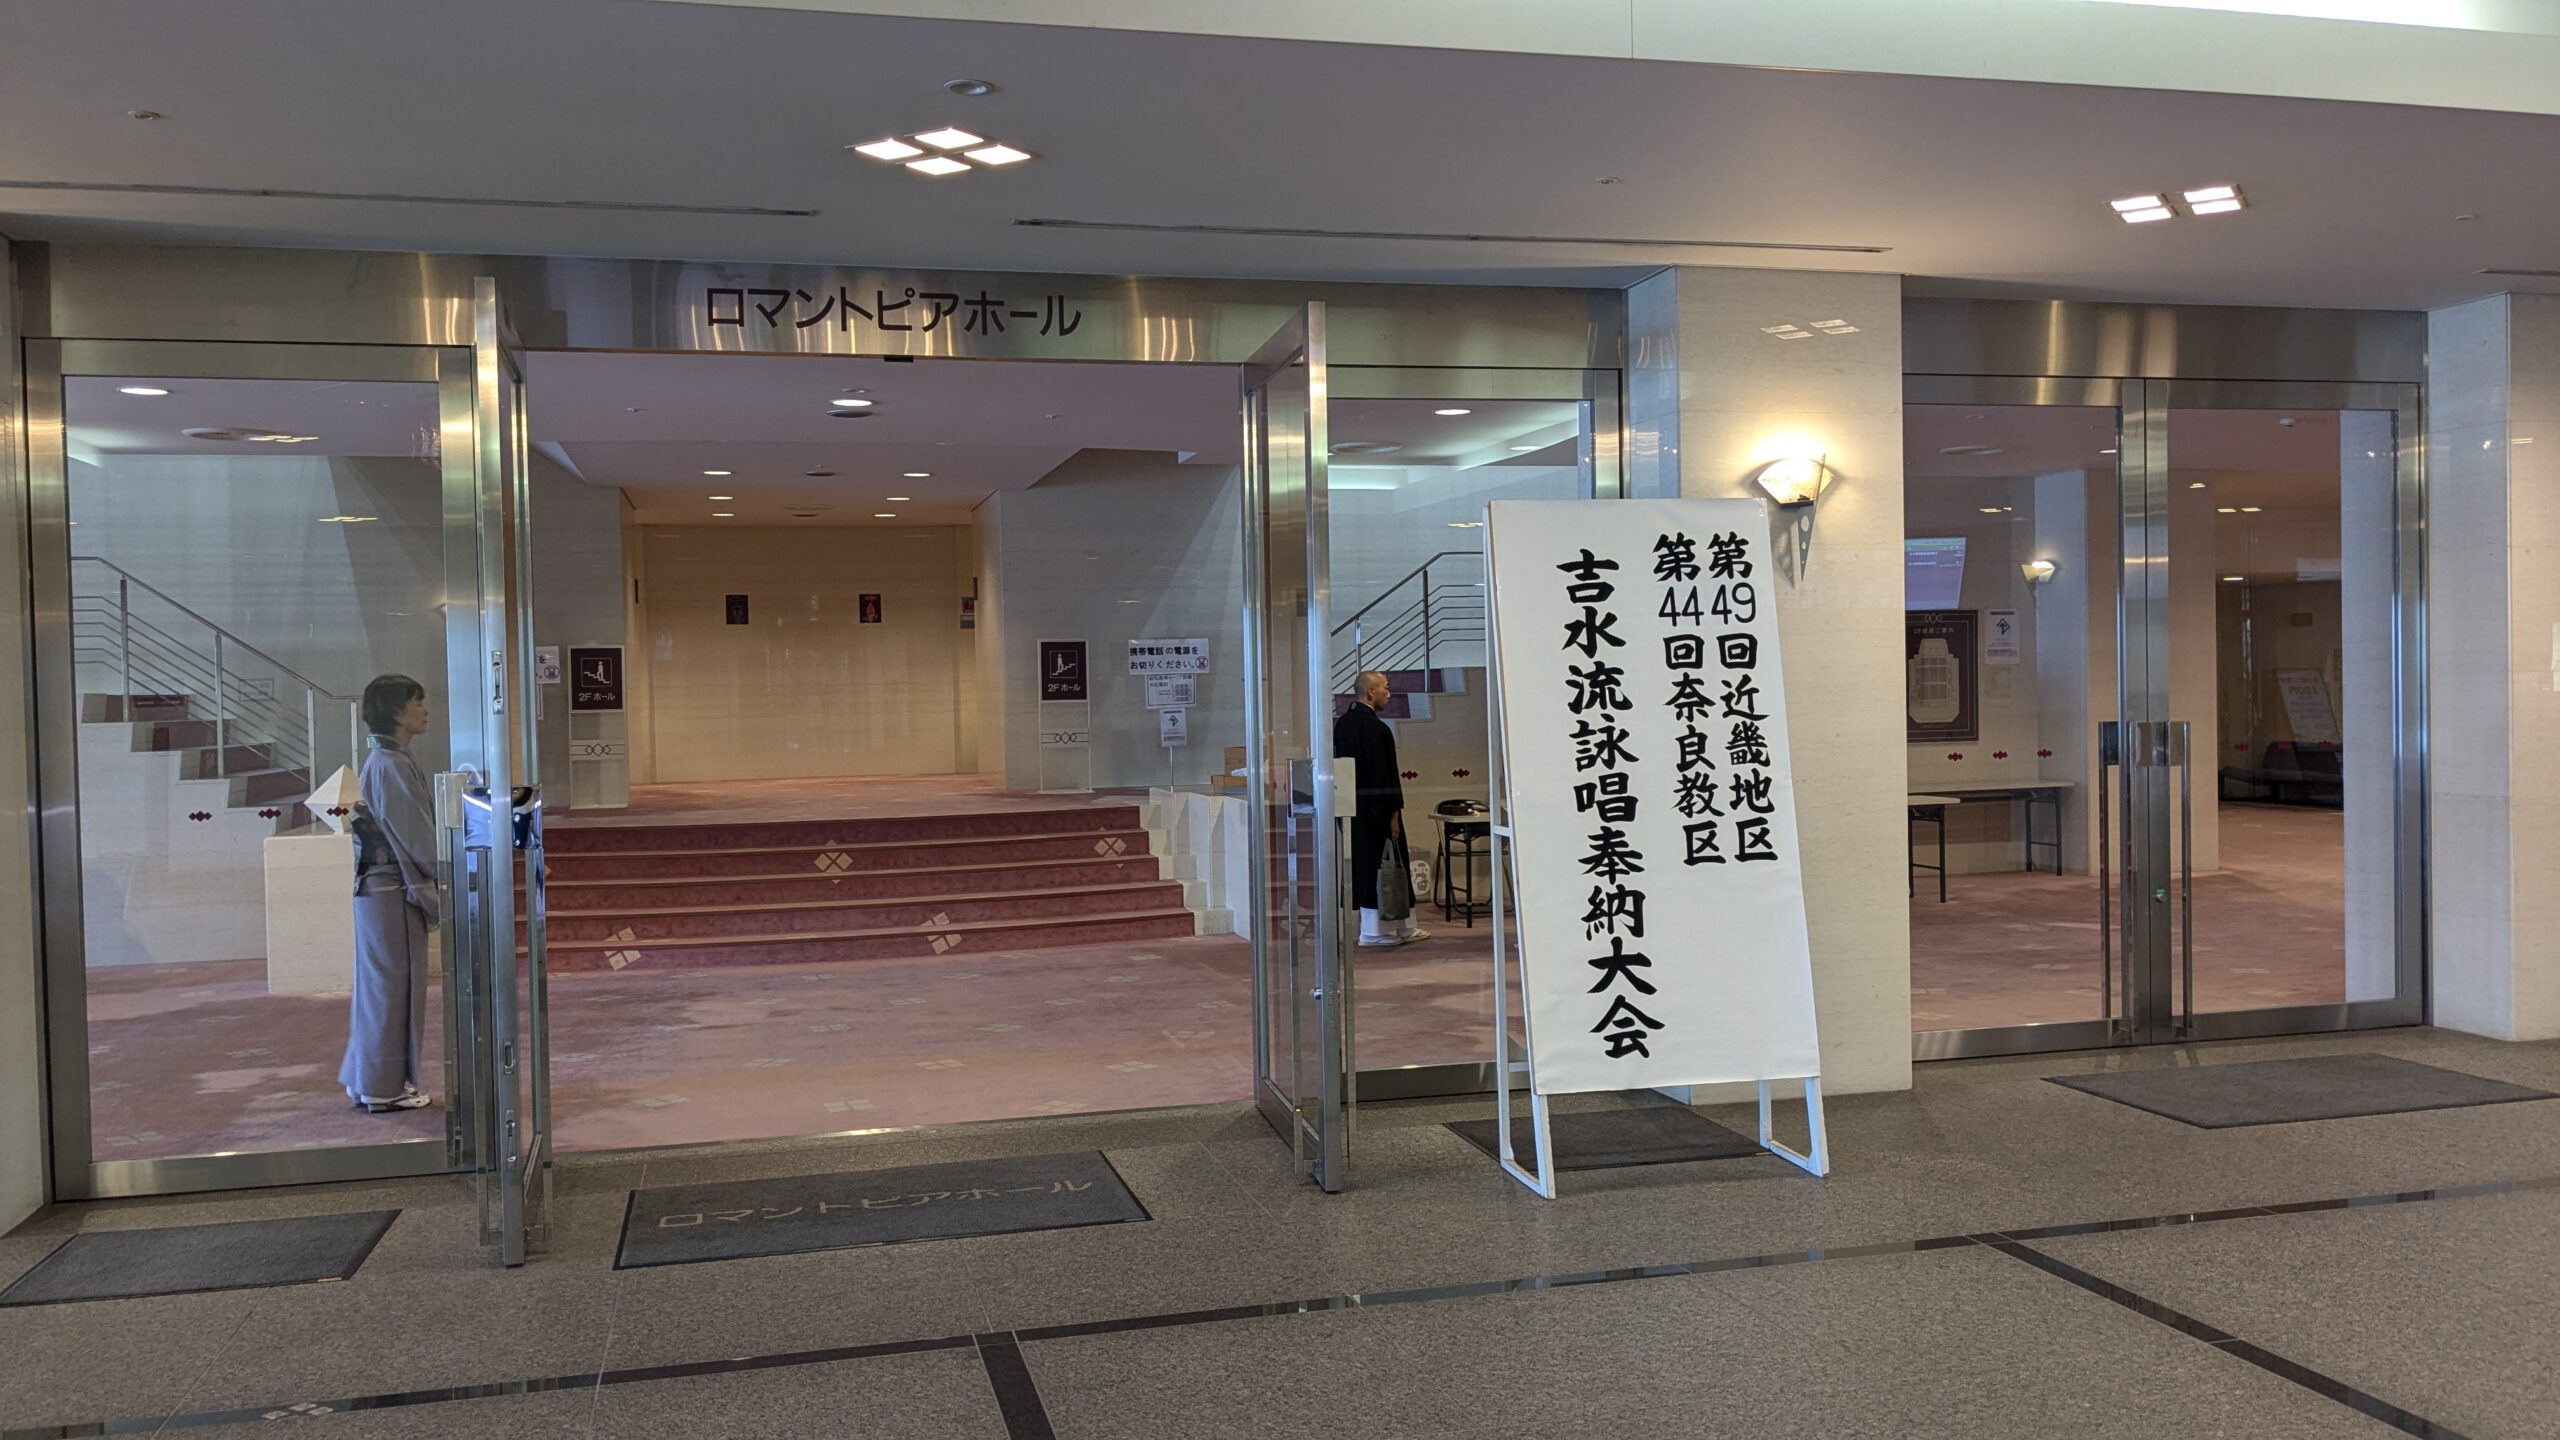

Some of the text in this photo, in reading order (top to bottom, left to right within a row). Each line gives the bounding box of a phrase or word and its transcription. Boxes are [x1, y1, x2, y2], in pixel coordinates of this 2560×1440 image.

[707, 286, 1081, 337] ロマントピアホール
[1556, 549, 1666, 1059] 吉水流詠唱奉納大会
[1652, 532, 1727, 866] 第44回奈良教区
[1707, 531, 1779, 863] 第49回近畿地区
[659, 1180, 1093, 1228] ロマントピアホール
